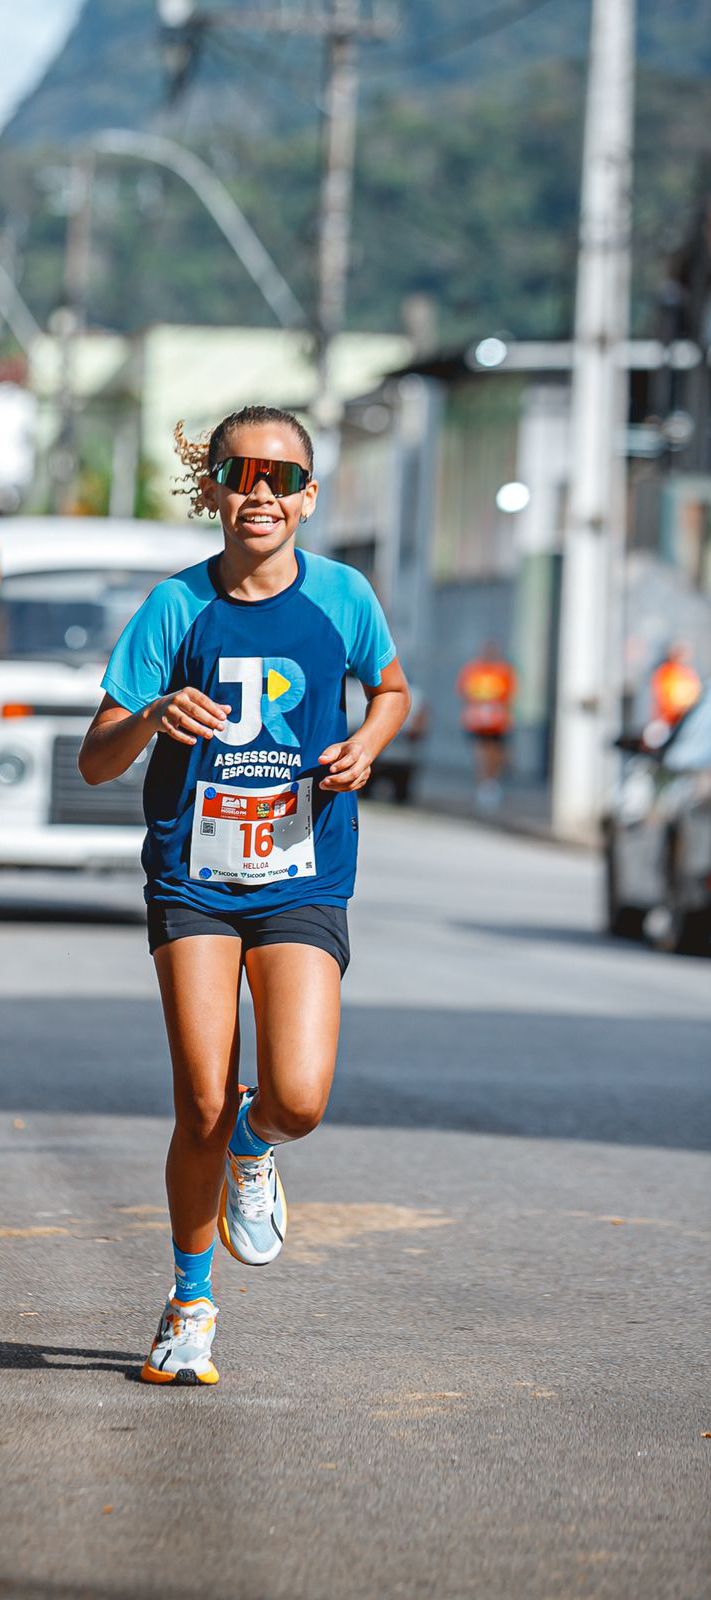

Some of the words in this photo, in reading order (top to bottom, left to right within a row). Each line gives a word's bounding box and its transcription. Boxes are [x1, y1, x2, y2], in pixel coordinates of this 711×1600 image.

[213, 657, 306, 748] JR
[214, 750, 301, 767] ASSESSORIA
[222, 765, 291, 780] ESPORTIVA
[240, 822, 274, 858] 16
